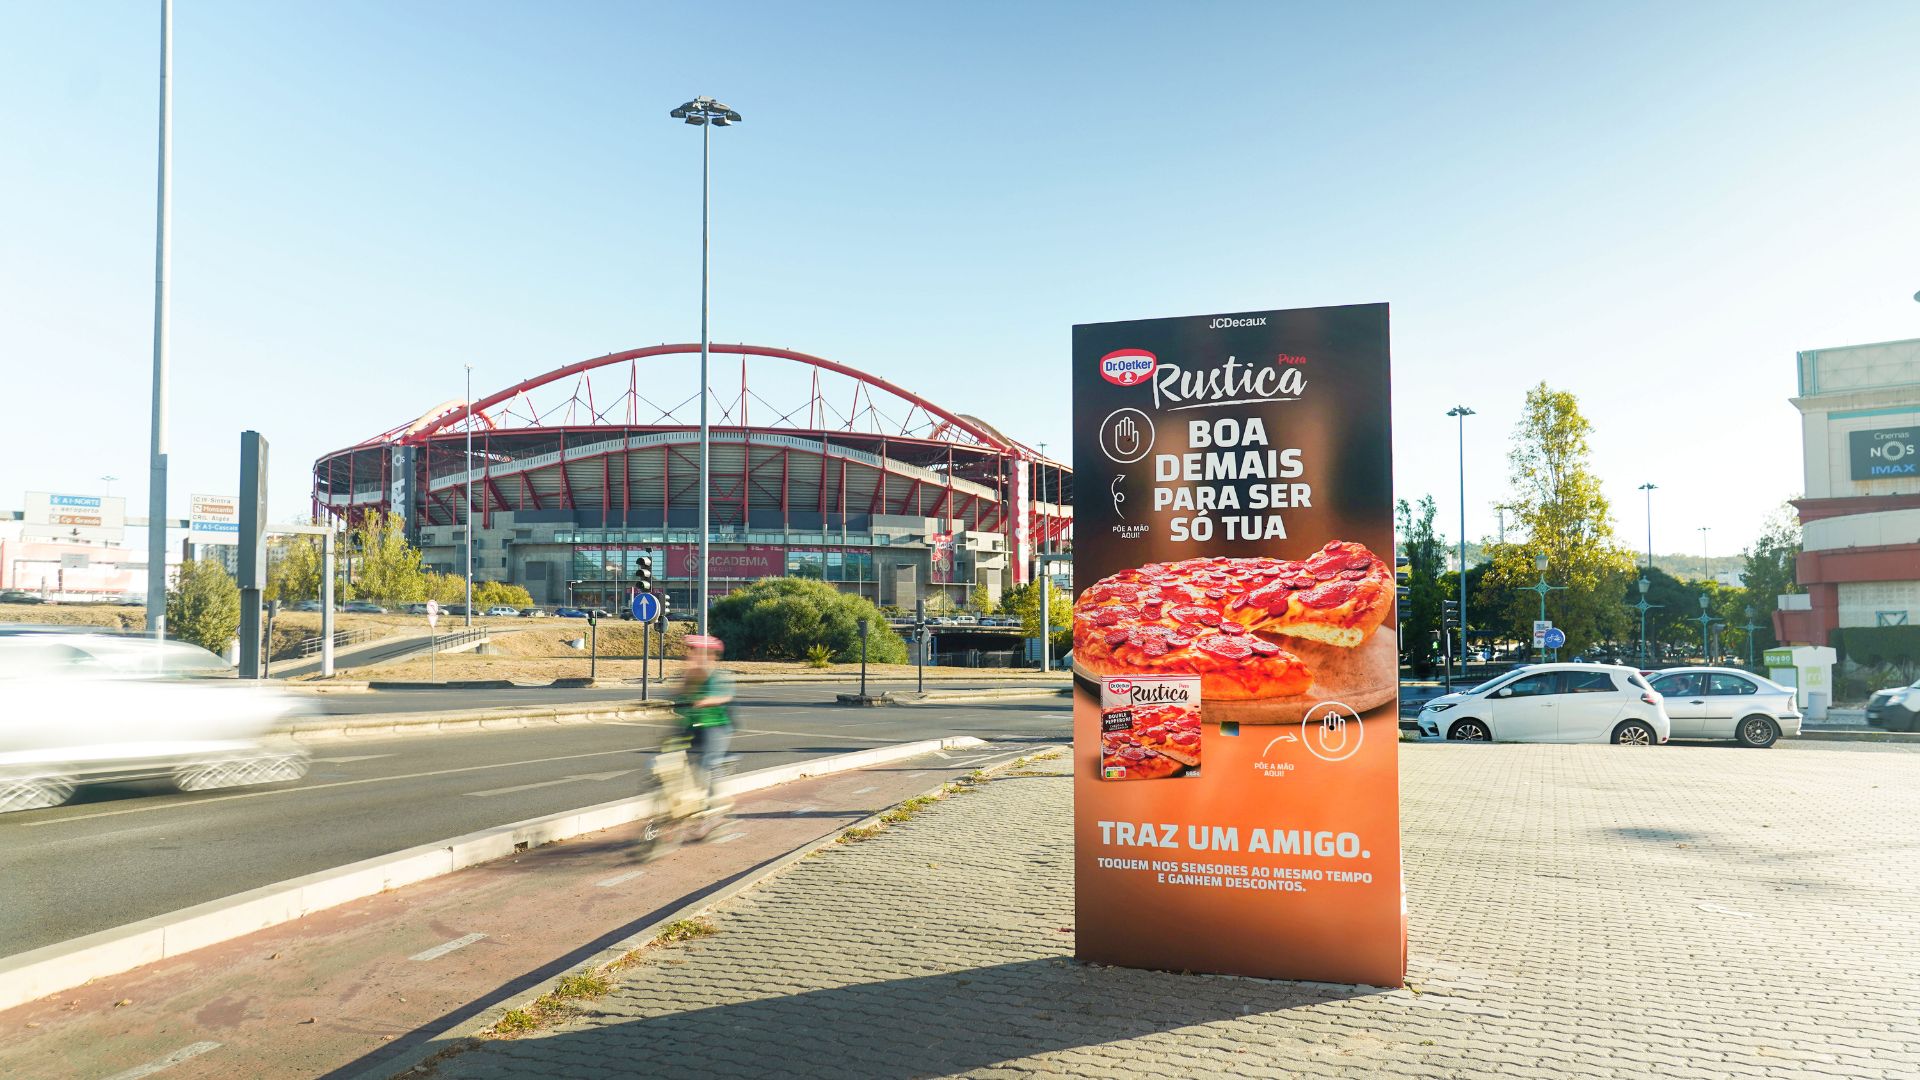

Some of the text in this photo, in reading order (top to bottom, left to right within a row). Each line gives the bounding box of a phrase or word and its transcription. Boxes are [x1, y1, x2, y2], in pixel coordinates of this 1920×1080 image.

[1209, 316, 1267, 329] JCDecaux
[1278, 353, 1307, 366] Pizza
[1153, 356, 1308, 410] Rustica
[1189, 417, 1269, 448] BOA
[1873, 432, 1910, 440] Cinemas
[1870, 440, 1915, 461] NOS
[1155, 448, 1304, 482] DEMAIS
[1871, 464, 1916, 475] IMAX
[1154, 483, 1312, 512] PARA SER
[1112, 524, 1126, 532] PÕE
[1133, 524, 1150, 532] MÃO
[1170, 510, 1287, 541] SÓ TUA
[1131, 683, 1189, 704] Rustica
[1097, 820, 1371, 859] TRAZ UM AMIGO.
[1097, 857, 1373, 884] TOQUEM NOS SENSORES AO MESMO TEMPO
[1158, 873, 1307, 892] E GANHEM DESCONTOS.
